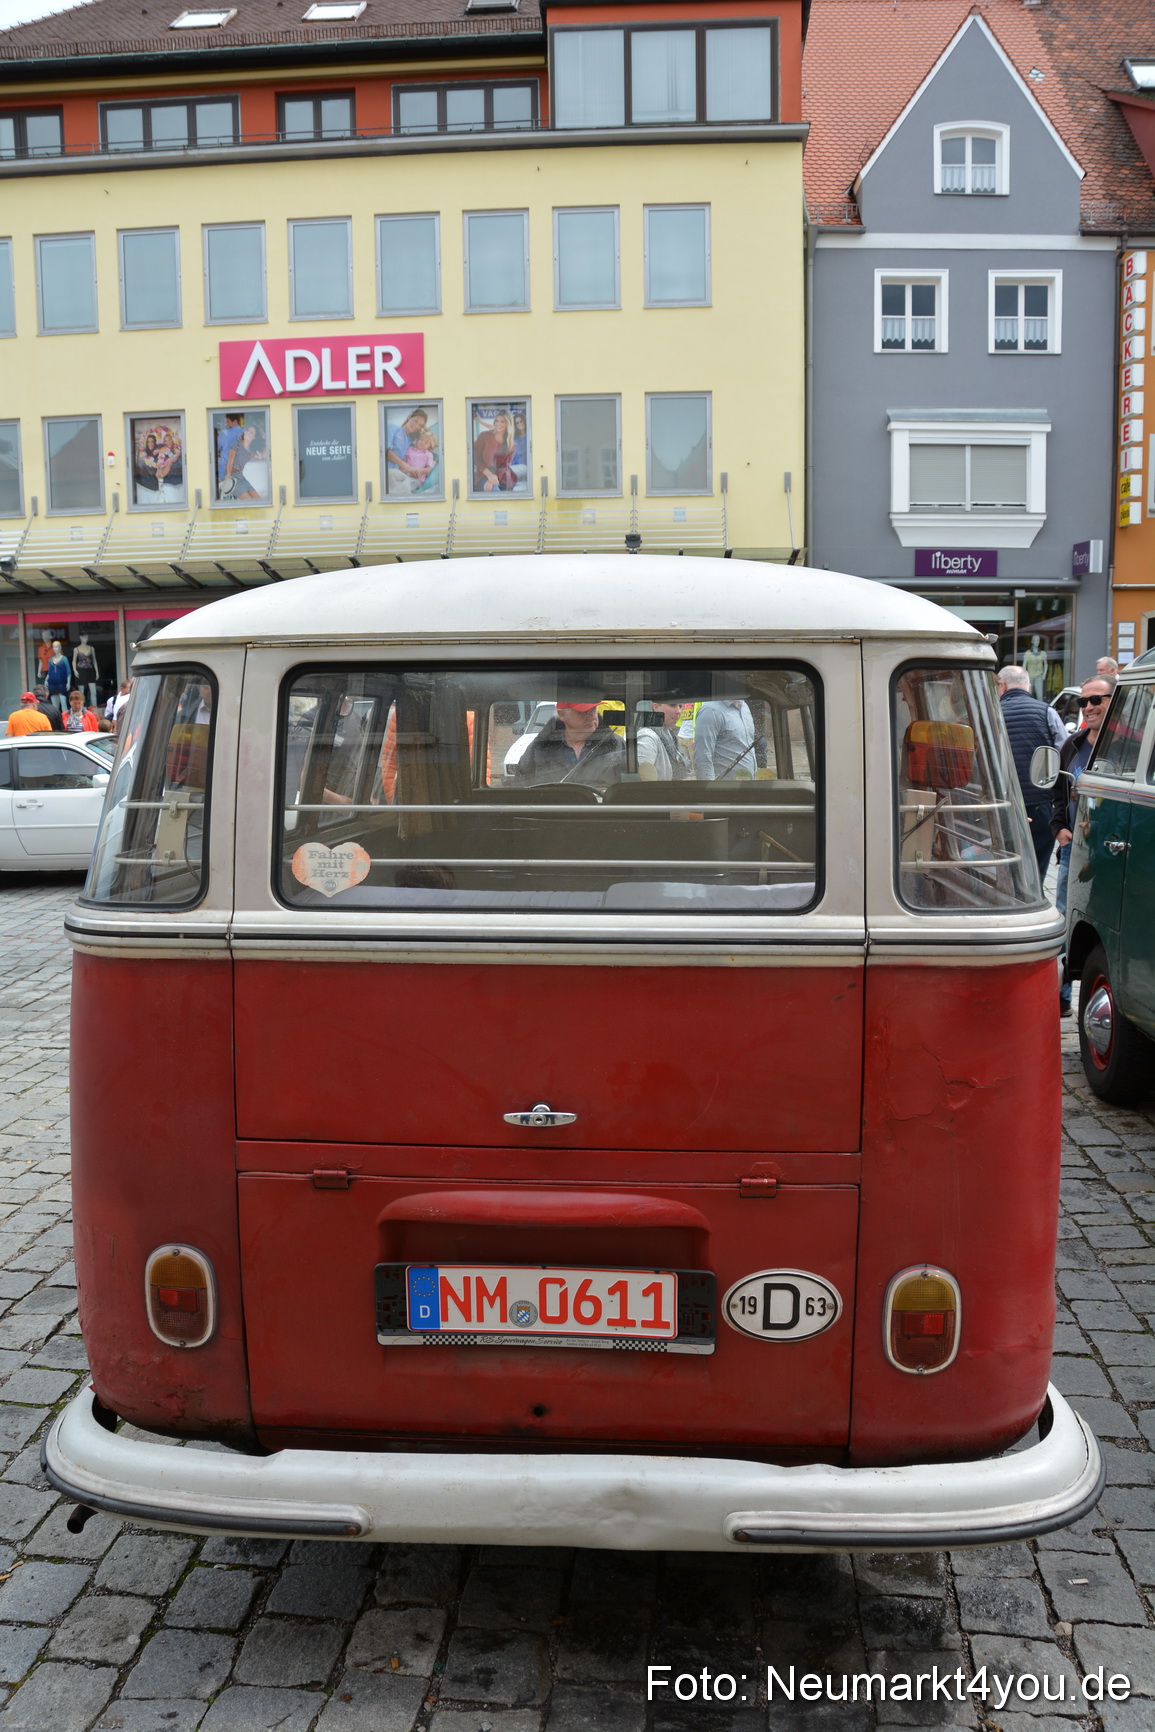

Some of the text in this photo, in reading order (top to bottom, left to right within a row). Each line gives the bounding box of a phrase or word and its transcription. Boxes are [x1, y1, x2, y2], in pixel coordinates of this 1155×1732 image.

[235, 340, 406, 397] ADLER
[1123, 257, 1134, 469] BÄCKEREI
[306, 445, 351, 456] NEUE SEITE
[931, 551, 982, 573] liberty
[1073, 550, 1089, 567] liberty
[308, 850, 354, 860] Fahre
[317, 859, 344, 869] mit
[311, 869, 349, 878] Herz
[419, 1304, 431, 1318] D
[439, 1275, 508, 1323] NM
[538, 1277, 671, 1330] 0611
[739, 1282, 827, 1330] 19 D 63
